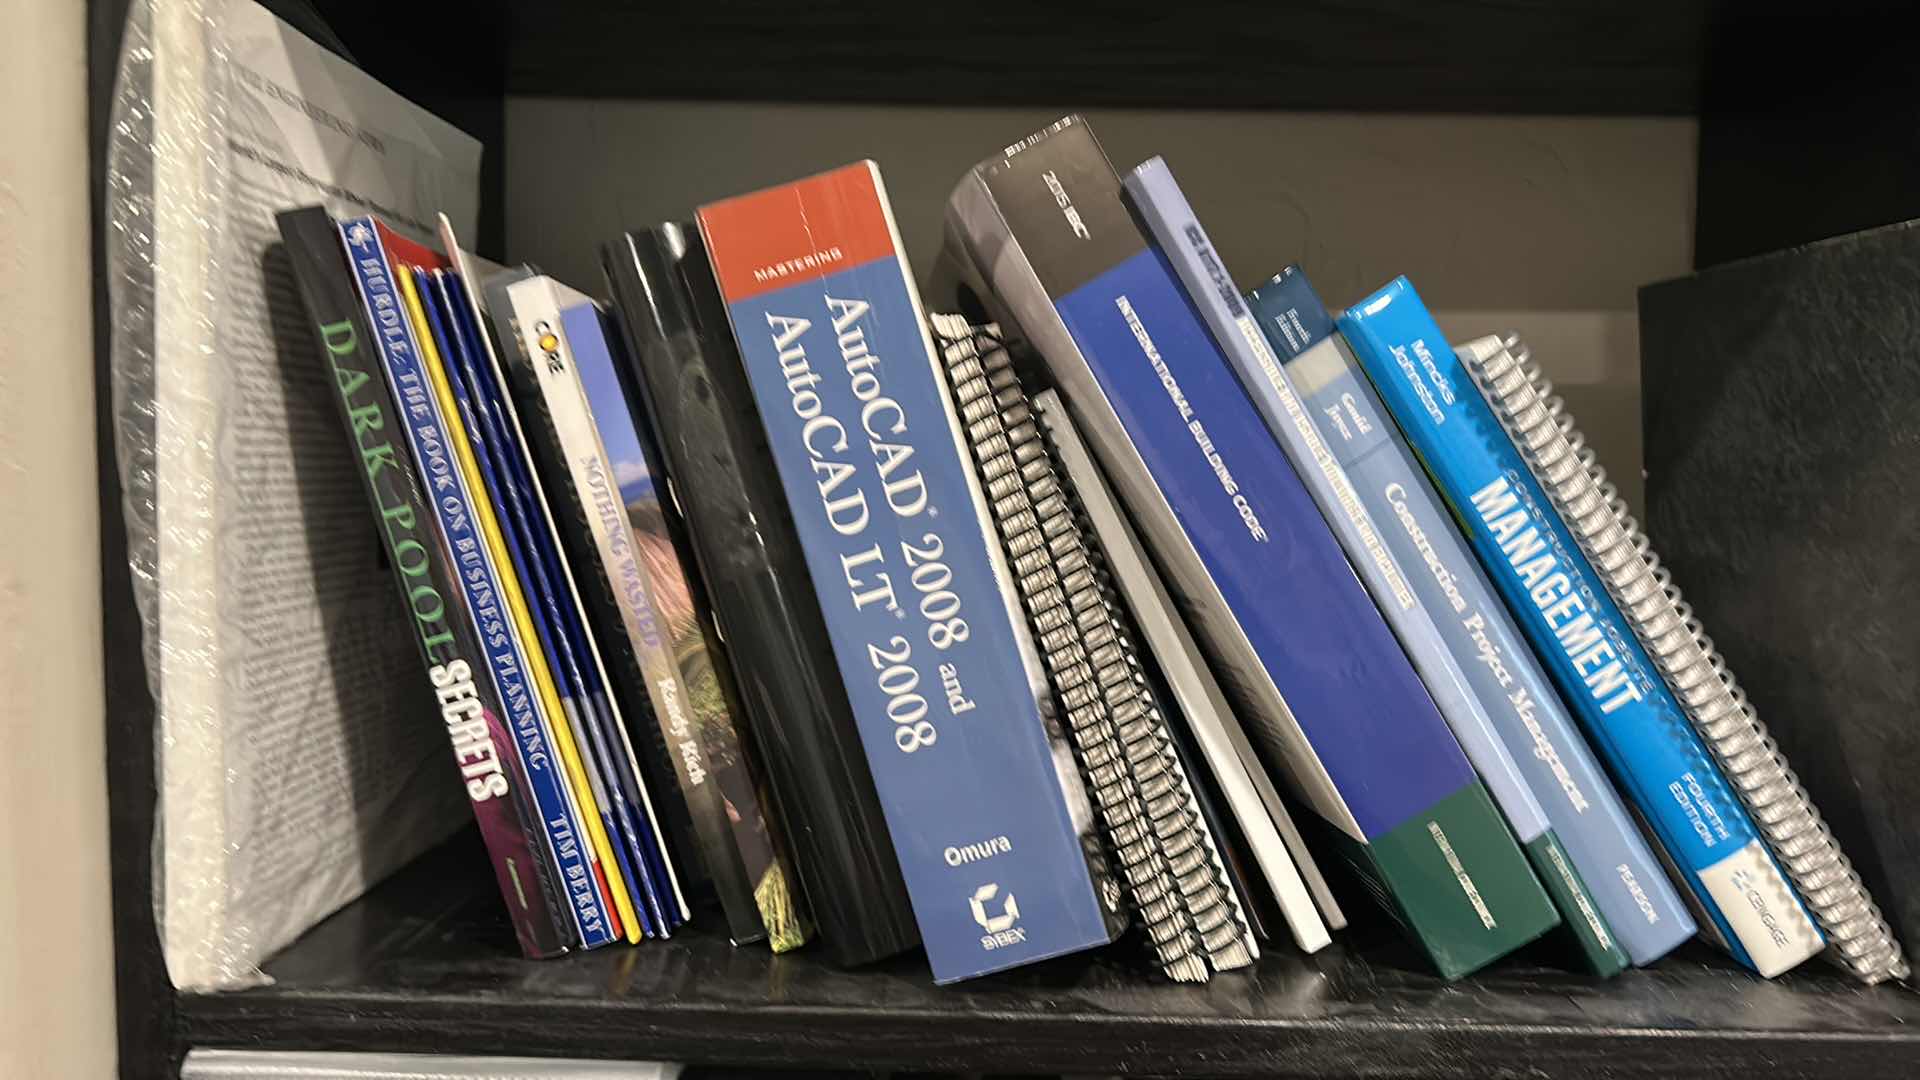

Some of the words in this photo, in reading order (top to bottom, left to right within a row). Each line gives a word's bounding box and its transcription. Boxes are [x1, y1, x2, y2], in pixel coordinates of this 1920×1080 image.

[753, 246, 844, 283] MASTERING
[320, 319, 400, 481] DARK
[383, 503, 456, 665] POOL
[400, 367, 431, 421] THE
[418, 424, 456, 490] BOOK
[443, 496, 467, 532] ON
[455, 537, 509, 648] BUSINESS
[496, 651, 550, 771] PLANNING
[579, 455, 629, 557] NOTHING
[620, 559, 661, 647] WASTED
[764, 311, 870, 535] AutoCAD
[867, 635, 938, 753] 2008
[901, 532, 970, 650] 2008
[938, 662, 977, 716] and
[1385, 482, 1468, 614] Construction
[1462, 611, 1513, 690] Project
[1508, 687, 1590, 814] Management
[1469, 475, 1644, 716] MANAGEMENT
[429, 659, 510, 802] SECRETS
[550, 812, 579, 860] TIM
[566, 860, 606, 933] BERRY
[943, 835, 1013, 867] Omura
